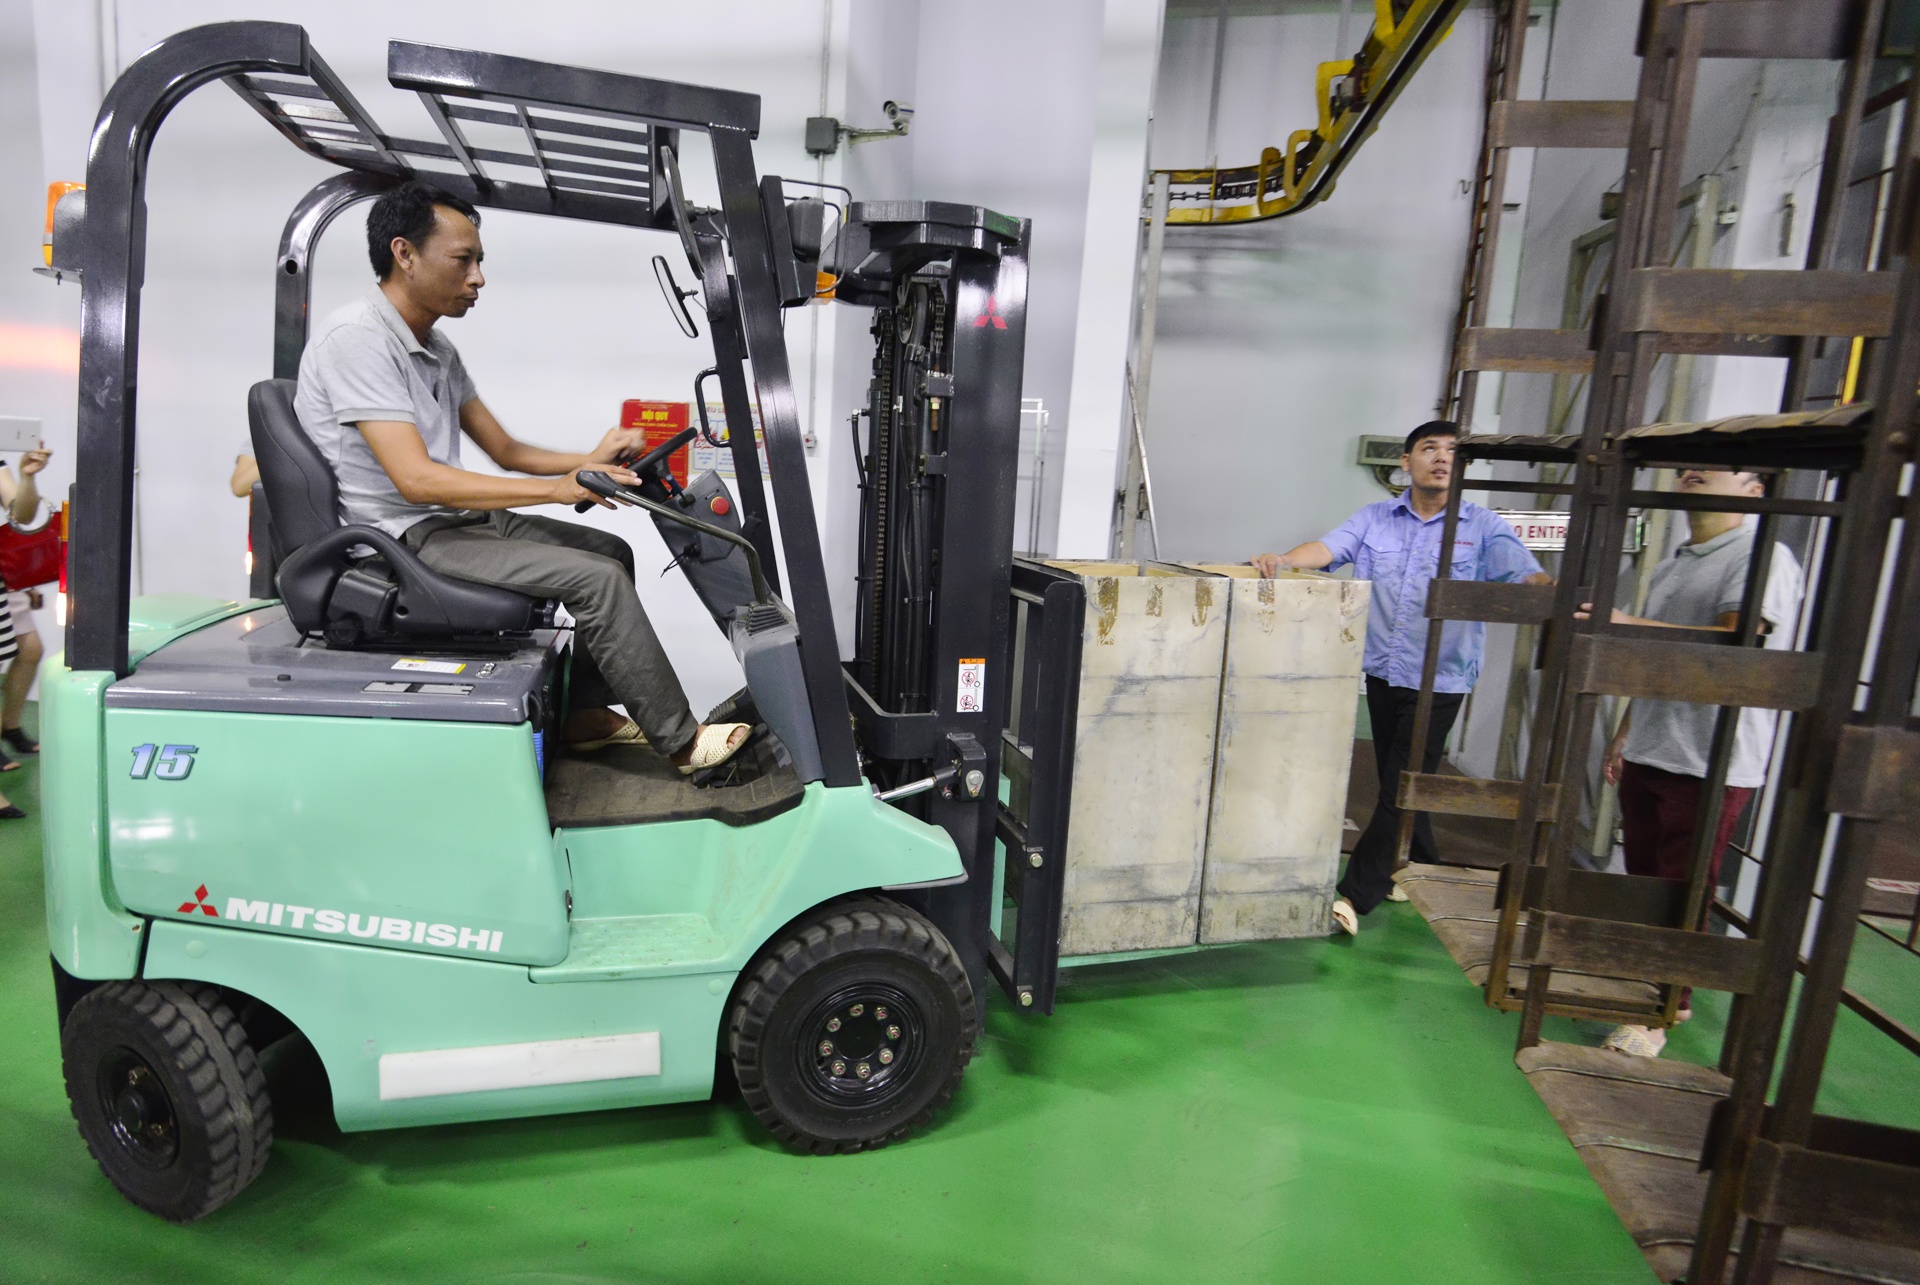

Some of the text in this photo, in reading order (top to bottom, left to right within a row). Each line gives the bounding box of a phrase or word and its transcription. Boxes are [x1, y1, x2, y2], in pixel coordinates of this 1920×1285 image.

[655, 411, 669, 421] QUY
[1528, 525, 1568, 539] ENTR
[129, 743, 200, 781] 15
[225, 896, 504, 953] MITSUBISHI
